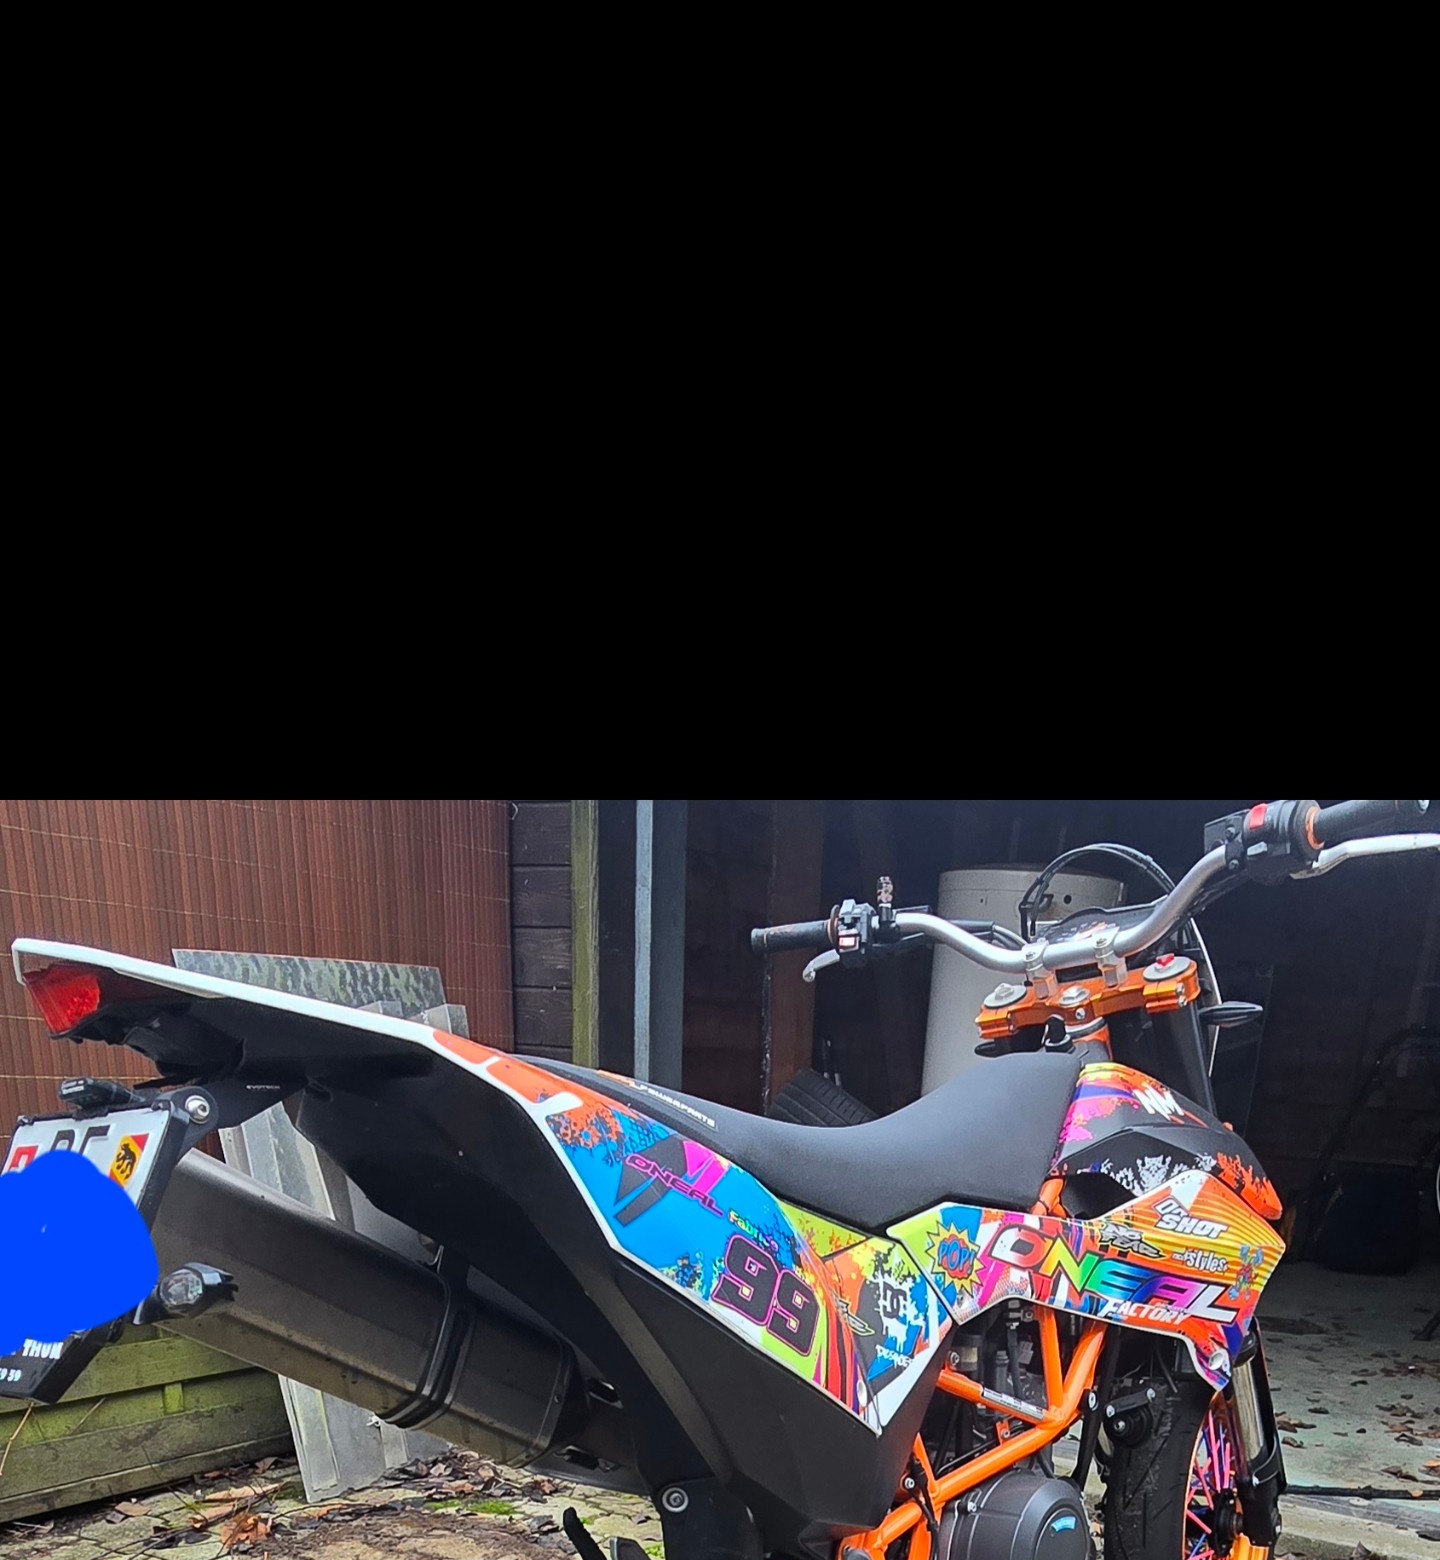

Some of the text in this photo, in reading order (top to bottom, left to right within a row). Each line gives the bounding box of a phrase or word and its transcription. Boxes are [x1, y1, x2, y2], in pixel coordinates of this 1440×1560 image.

[1154, 1213, 1228, 1239] SHOT
[938, 1239, 977, 1276] POP!
[1100, 1230, 1165, 1258] FEAR
[988, 1223, 1241, 1325] ONEAL
[711, 1234, 821, 1357] 99
[1099, 1299, 1191, 1326] FACTORY
[22, 1338, 64, 1360] THUN
